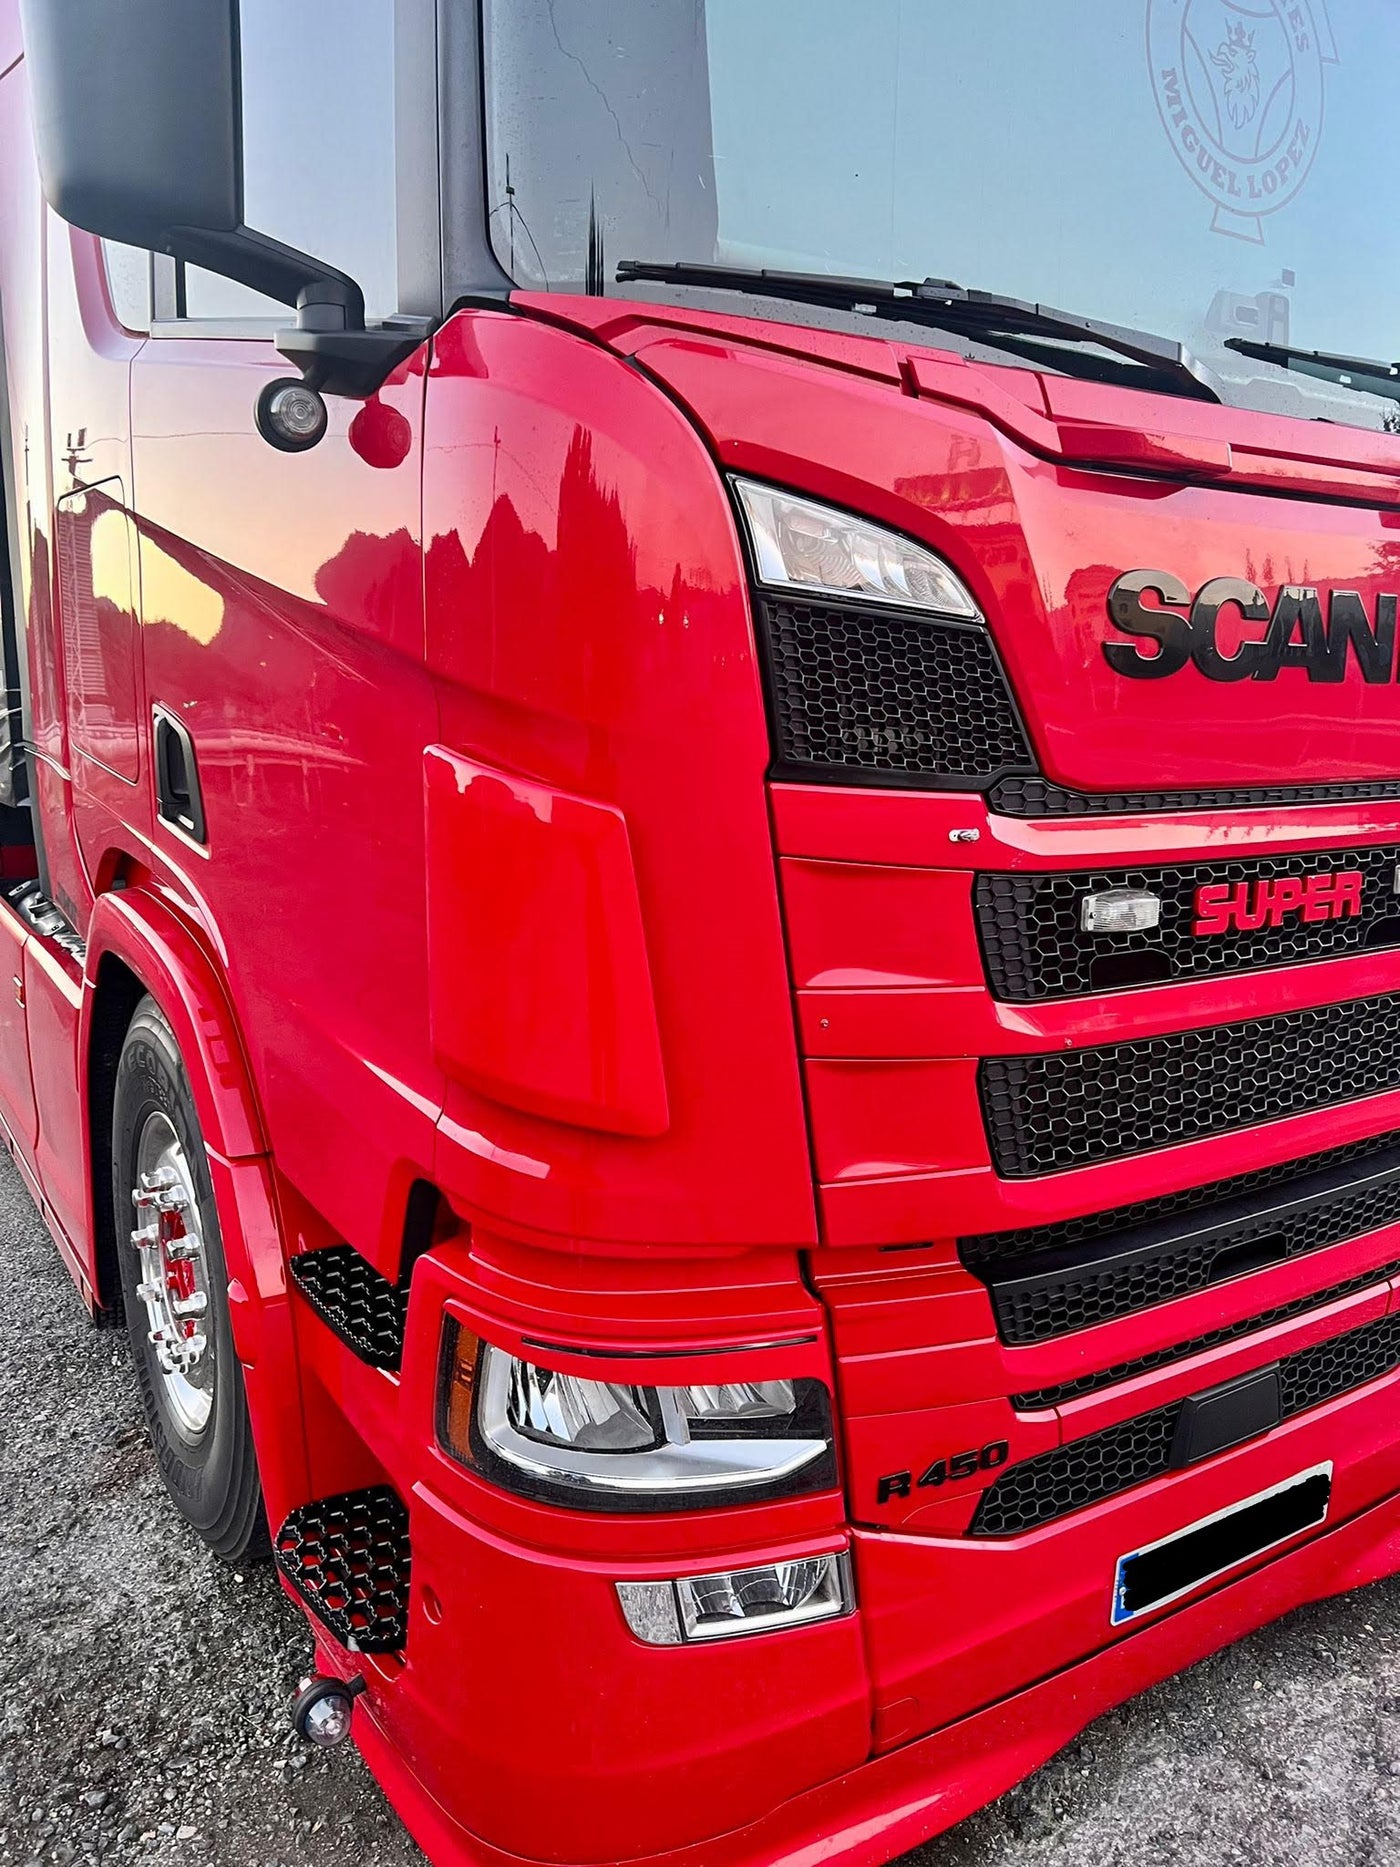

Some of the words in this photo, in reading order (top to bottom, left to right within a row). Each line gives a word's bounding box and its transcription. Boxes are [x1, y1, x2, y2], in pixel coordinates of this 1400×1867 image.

[1161, 67, 1241, 198] MIGUEL
[1246, 117, 1310, 200] LOPEZ
[1102, 568, 1400, 684] SCAN
[1191, 870, 1363, 936] SUPER
[877, 1469, 911, 1505] R
[916, 1439, 1009, 1488] 450
